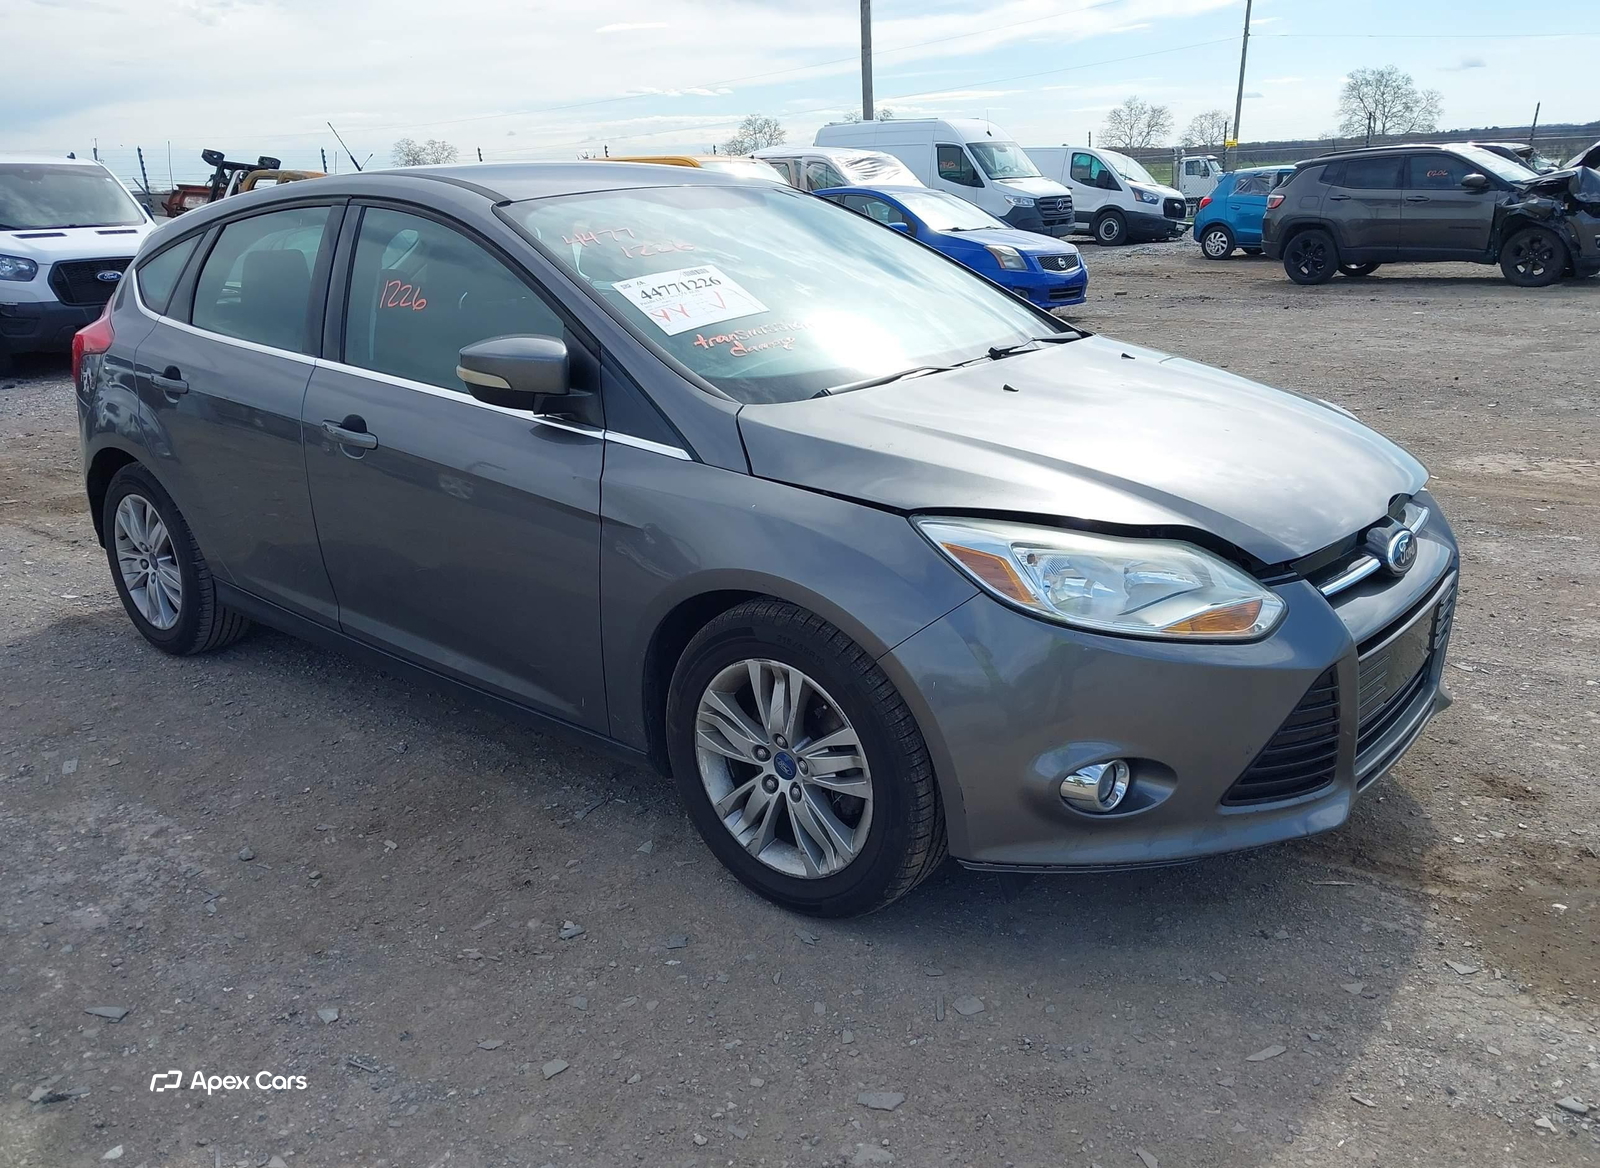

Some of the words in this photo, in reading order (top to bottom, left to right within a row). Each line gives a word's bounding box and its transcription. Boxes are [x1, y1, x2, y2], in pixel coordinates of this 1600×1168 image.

[561, 228, 635, 248] 4477
[621, 239, 695, 259] 1226
[380, 279, 428, 311] 1226
[640, 276, 722, 300] 44771226
[1398, 537, 1416, 564] Ford
